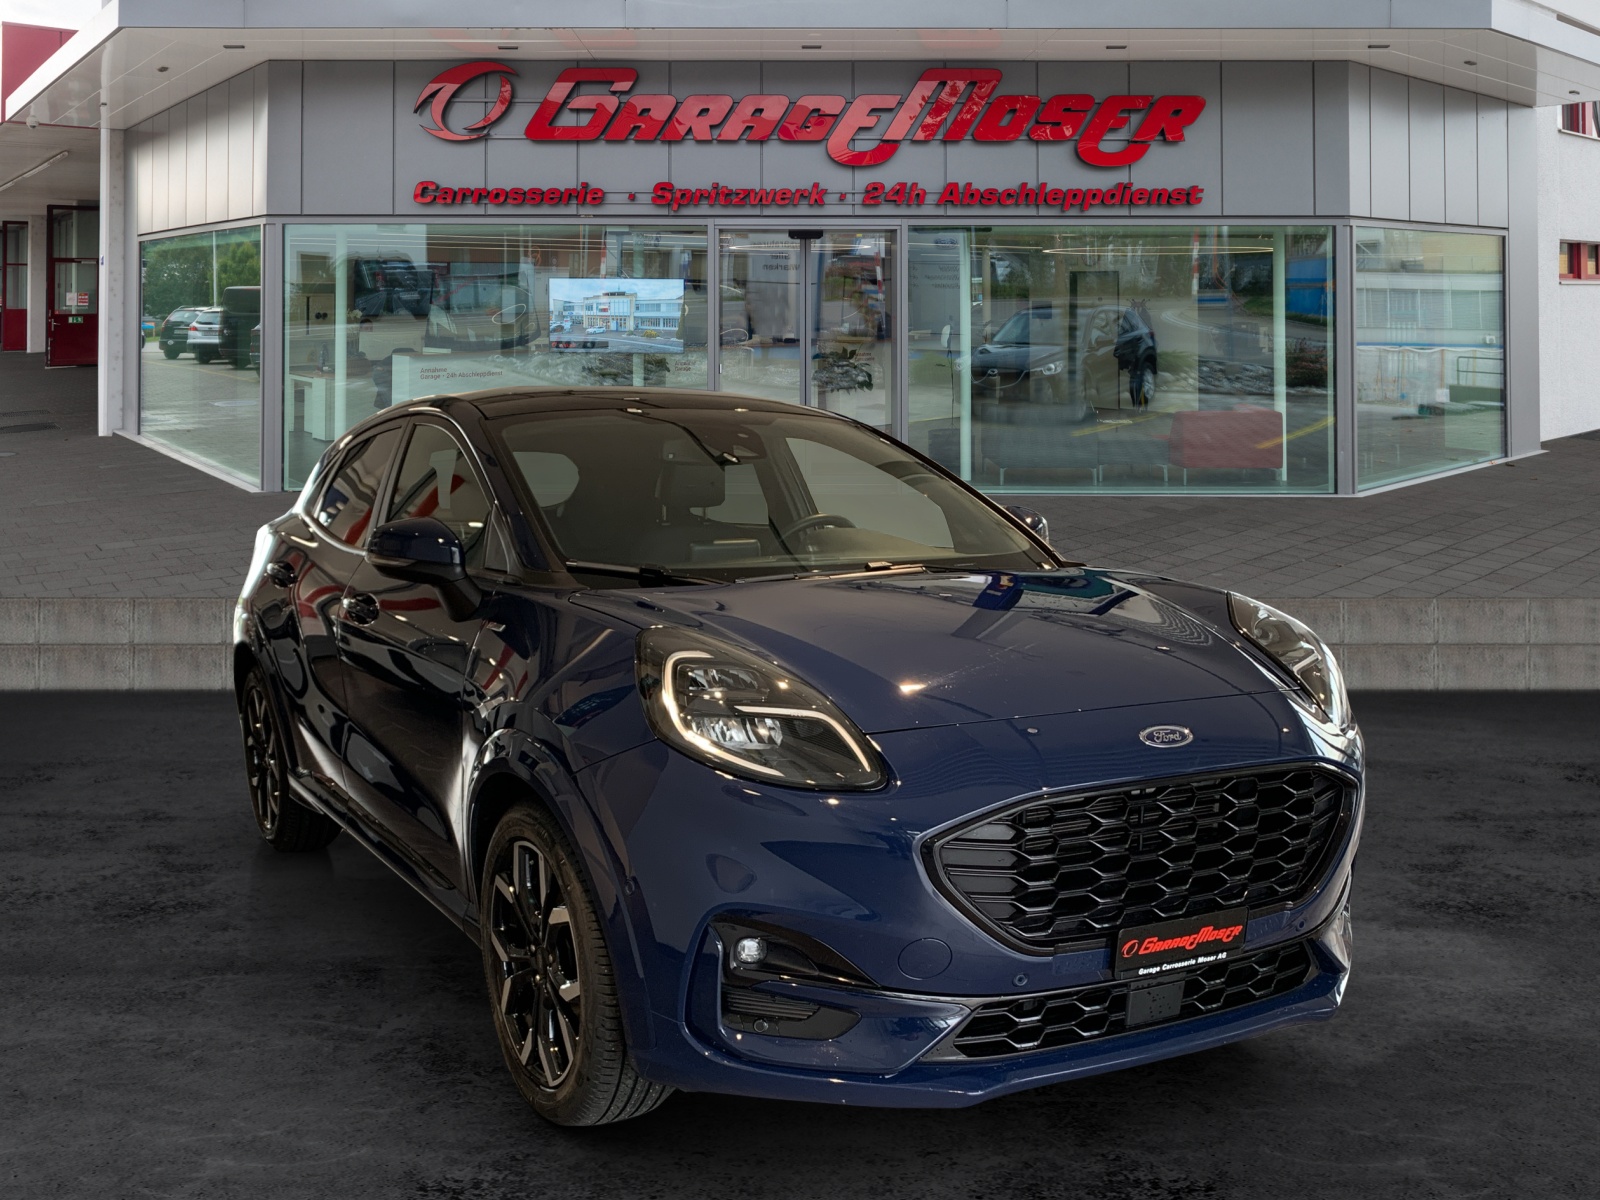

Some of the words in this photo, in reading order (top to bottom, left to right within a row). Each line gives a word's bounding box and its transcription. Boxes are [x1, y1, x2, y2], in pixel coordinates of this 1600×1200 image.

[413, 180, 604, 205] Carrosserie
[651, 181, 826, 211] Spritzwerk
[862, 182, 927, 205] 24h
[938, 182, 1204, 211] Abschleppdienst
[458, 370, 503, 379] Abschleppdienst
[1153, 730, 1182, 743] Ford
[1138, 966, 1160, 976] Garage
[1162, 958, 1196, 971] Carrosserie
[1197, 954, 1217, 964] Moser
[1217, 951, 1227, 960] AG
